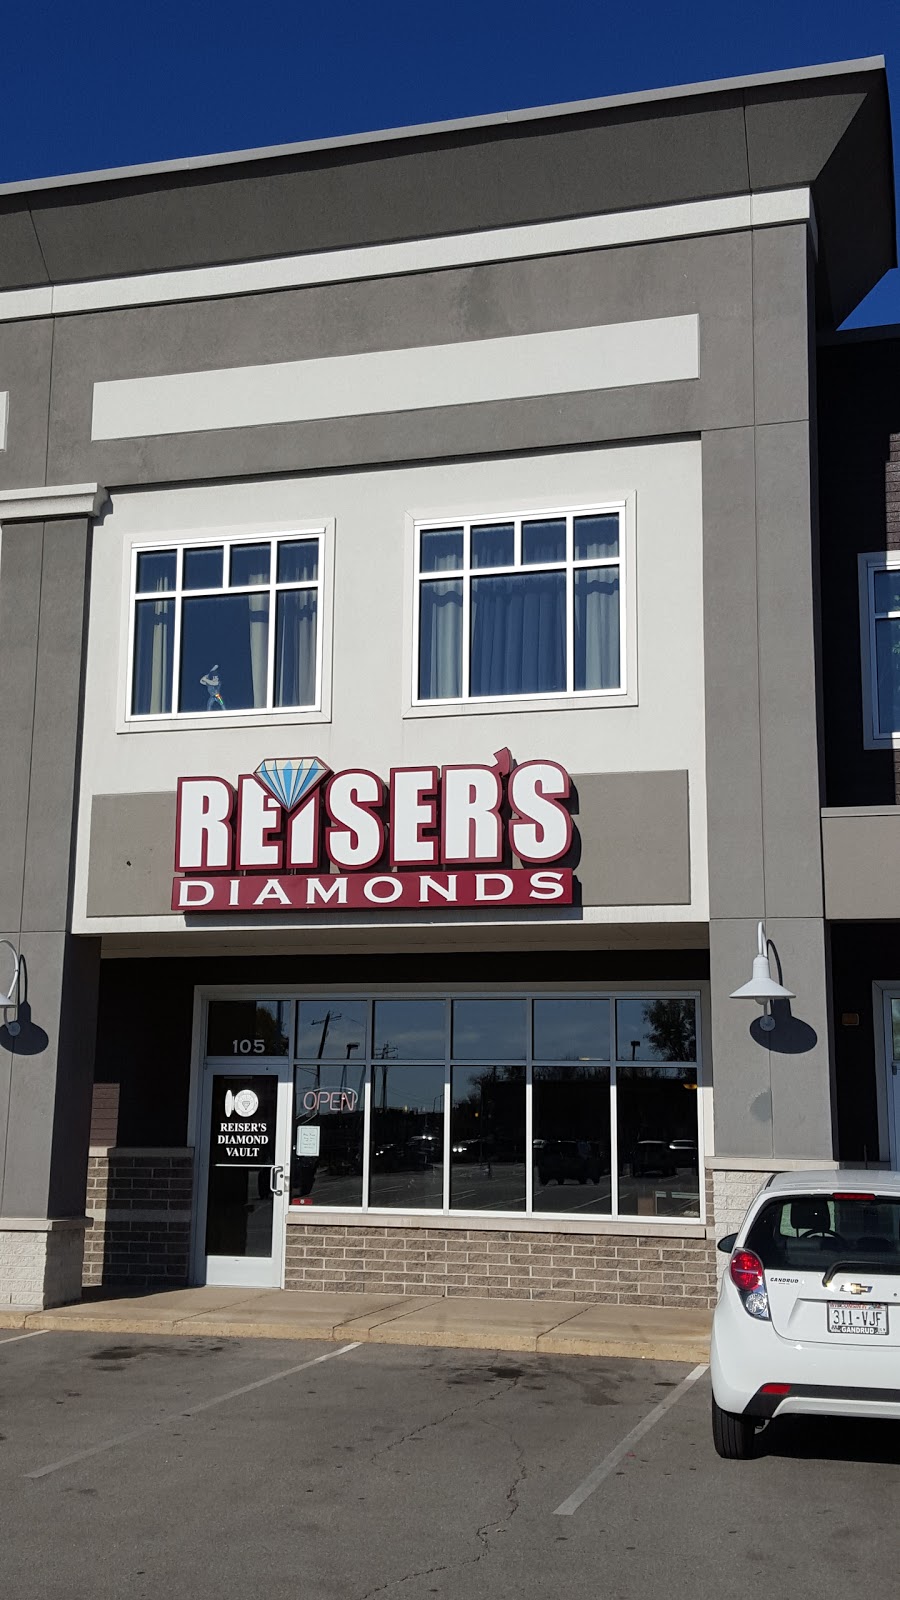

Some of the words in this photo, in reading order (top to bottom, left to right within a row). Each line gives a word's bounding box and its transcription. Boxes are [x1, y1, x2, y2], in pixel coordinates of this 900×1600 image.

[174, 746, 573, 872] REISER'S
[177, 871, 565, 907] DIAMONDS
[232, 1039, 265, 1054] 105
[303, 1091, 355, 1111] OPEN
[219, 1122, 267, 1132] REISER'S
[217, 1135, 269, 1145] DIAMOND
[225, 1147, 260, 1157] VAULT
[833, 1309, 882, 1327] 311-VJF
[841, 1326, 875, 1334] GANDRUD
